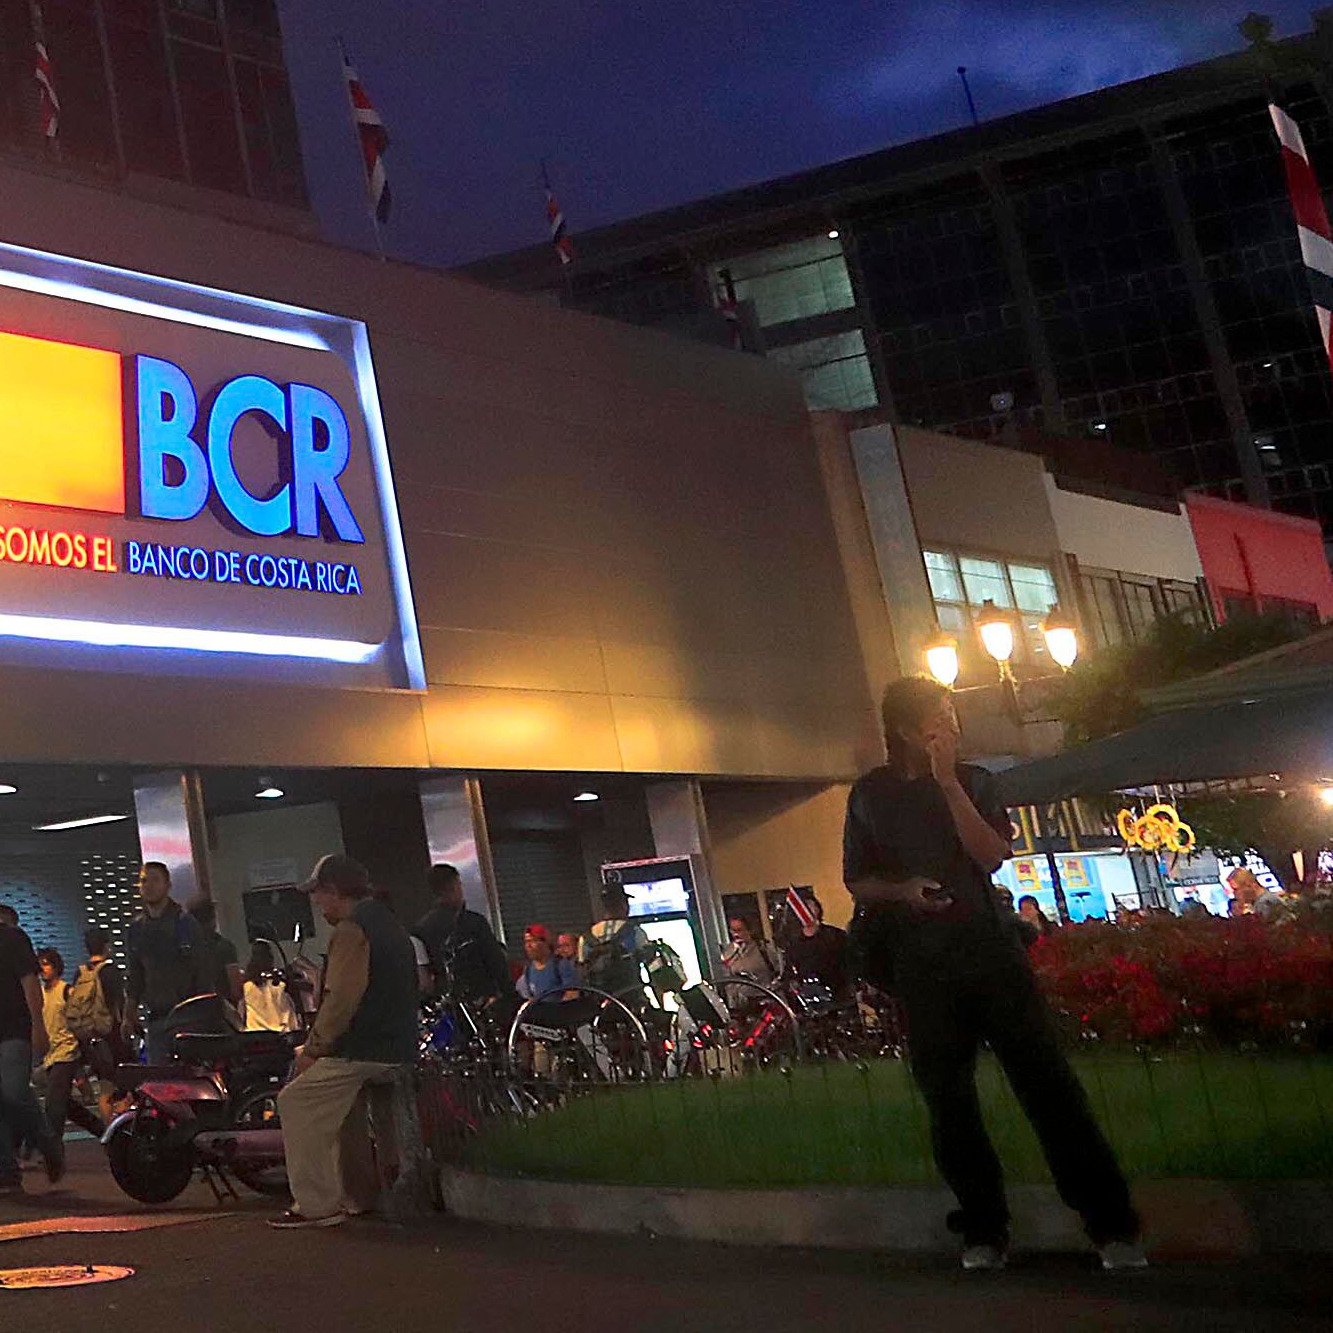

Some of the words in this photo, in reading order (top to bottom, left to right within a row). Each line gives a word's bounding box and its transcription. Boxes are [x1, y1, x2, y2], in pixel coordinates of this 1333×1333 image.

[136, 353, 365, 543] BCR
[91, 537, 118, 573] EL
[128, 541, 210, 580] BANCO
[214, 552, 241, 584] DE
[244, 554, 312, 592] COSTA
[316, 563, 362, 595] RICA
